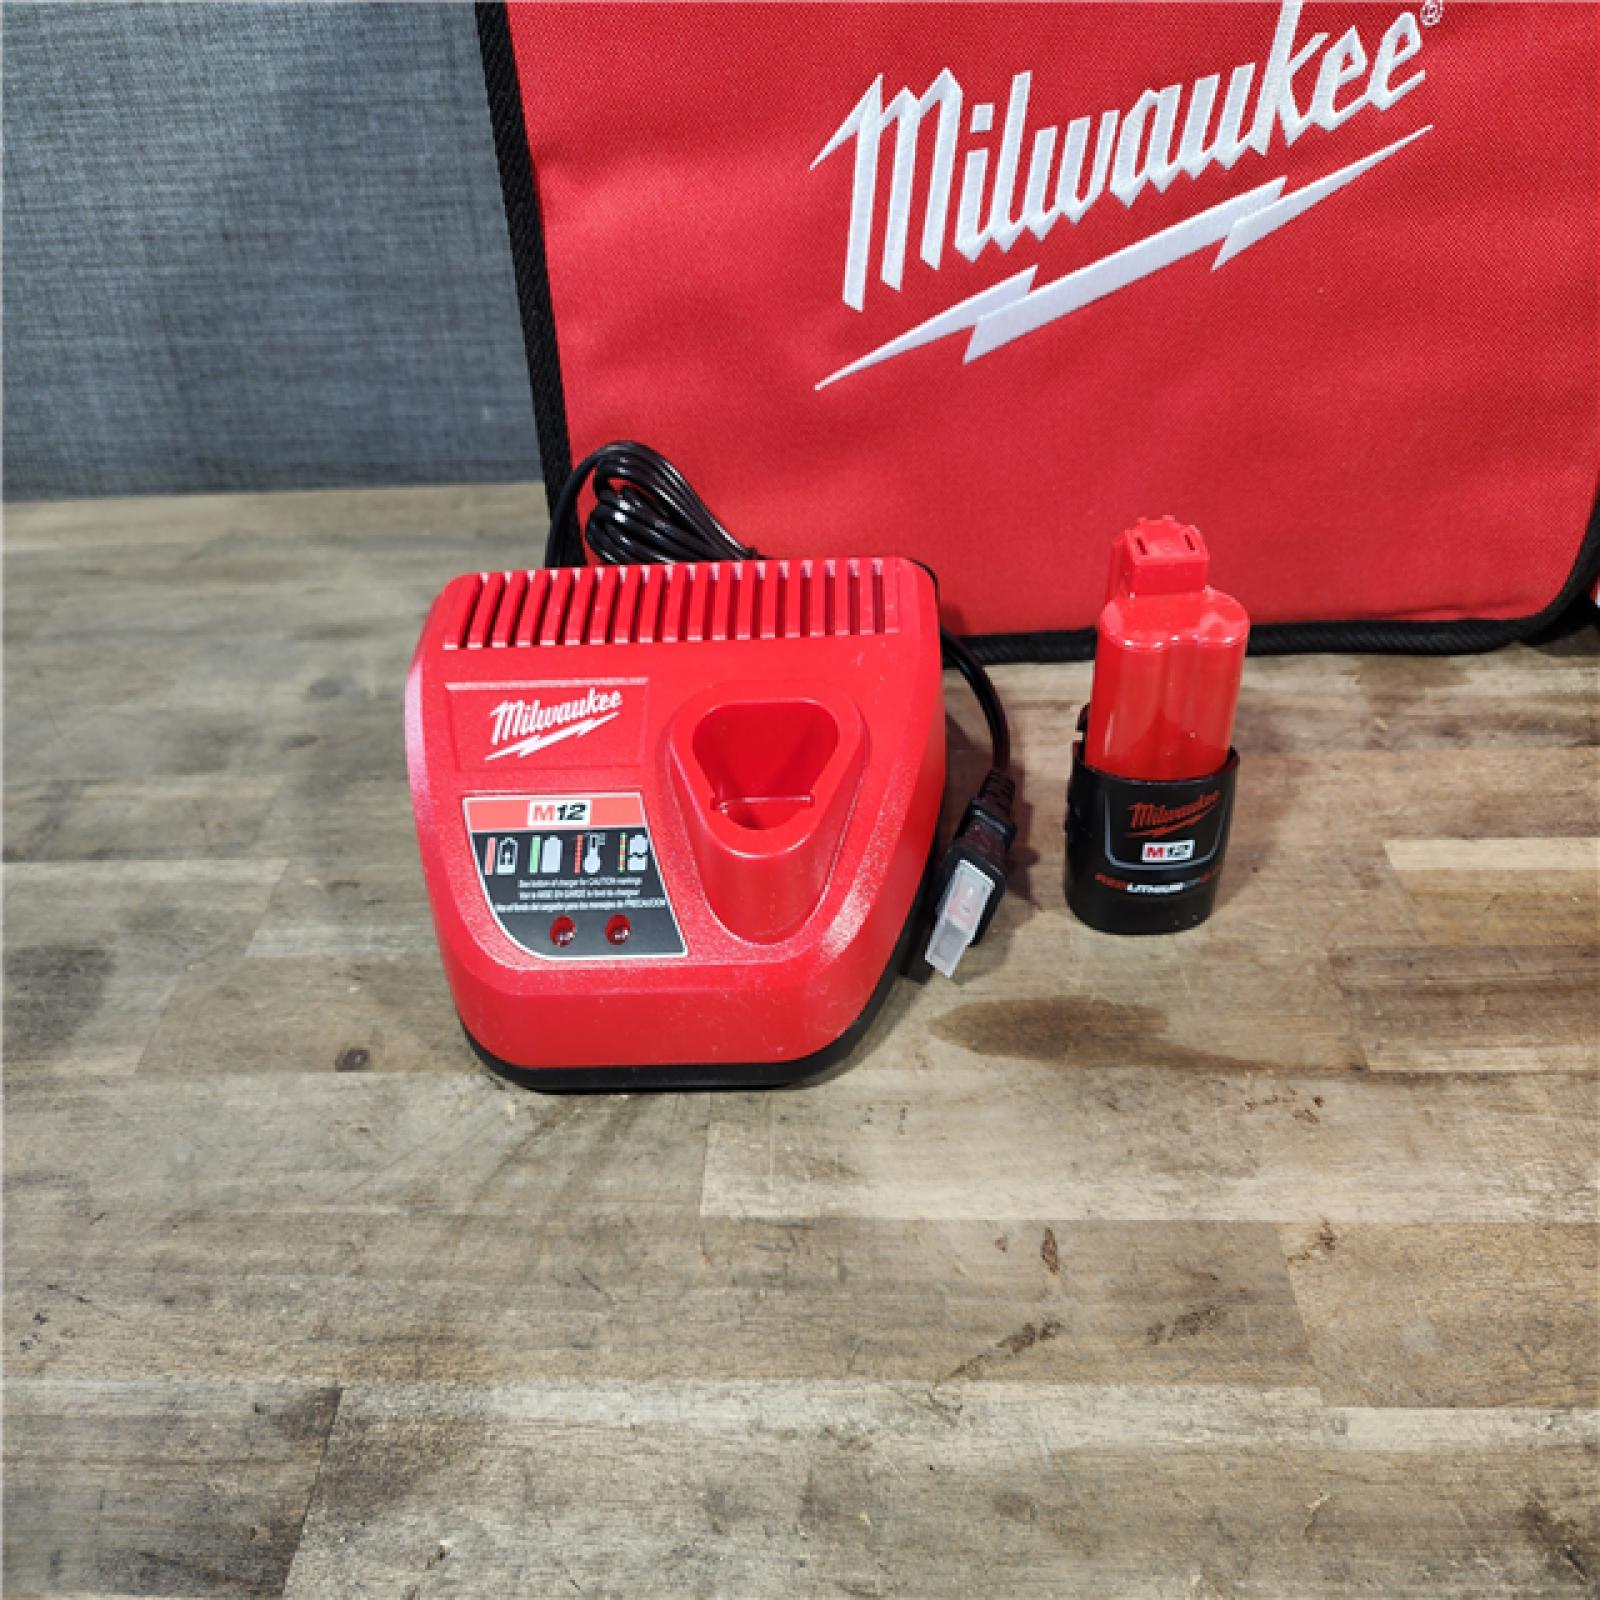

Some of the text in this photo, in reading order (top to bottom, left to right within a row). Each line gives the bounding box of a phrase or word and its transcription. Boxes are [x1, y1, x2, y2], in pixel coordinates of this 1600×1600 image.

[809, 0, 1426, 312] Milwaukee
[489, 687, 622, 745] Milwaukee
[532, 801, 587, 821] M12
[1145, 844, 1191, 858] M12
